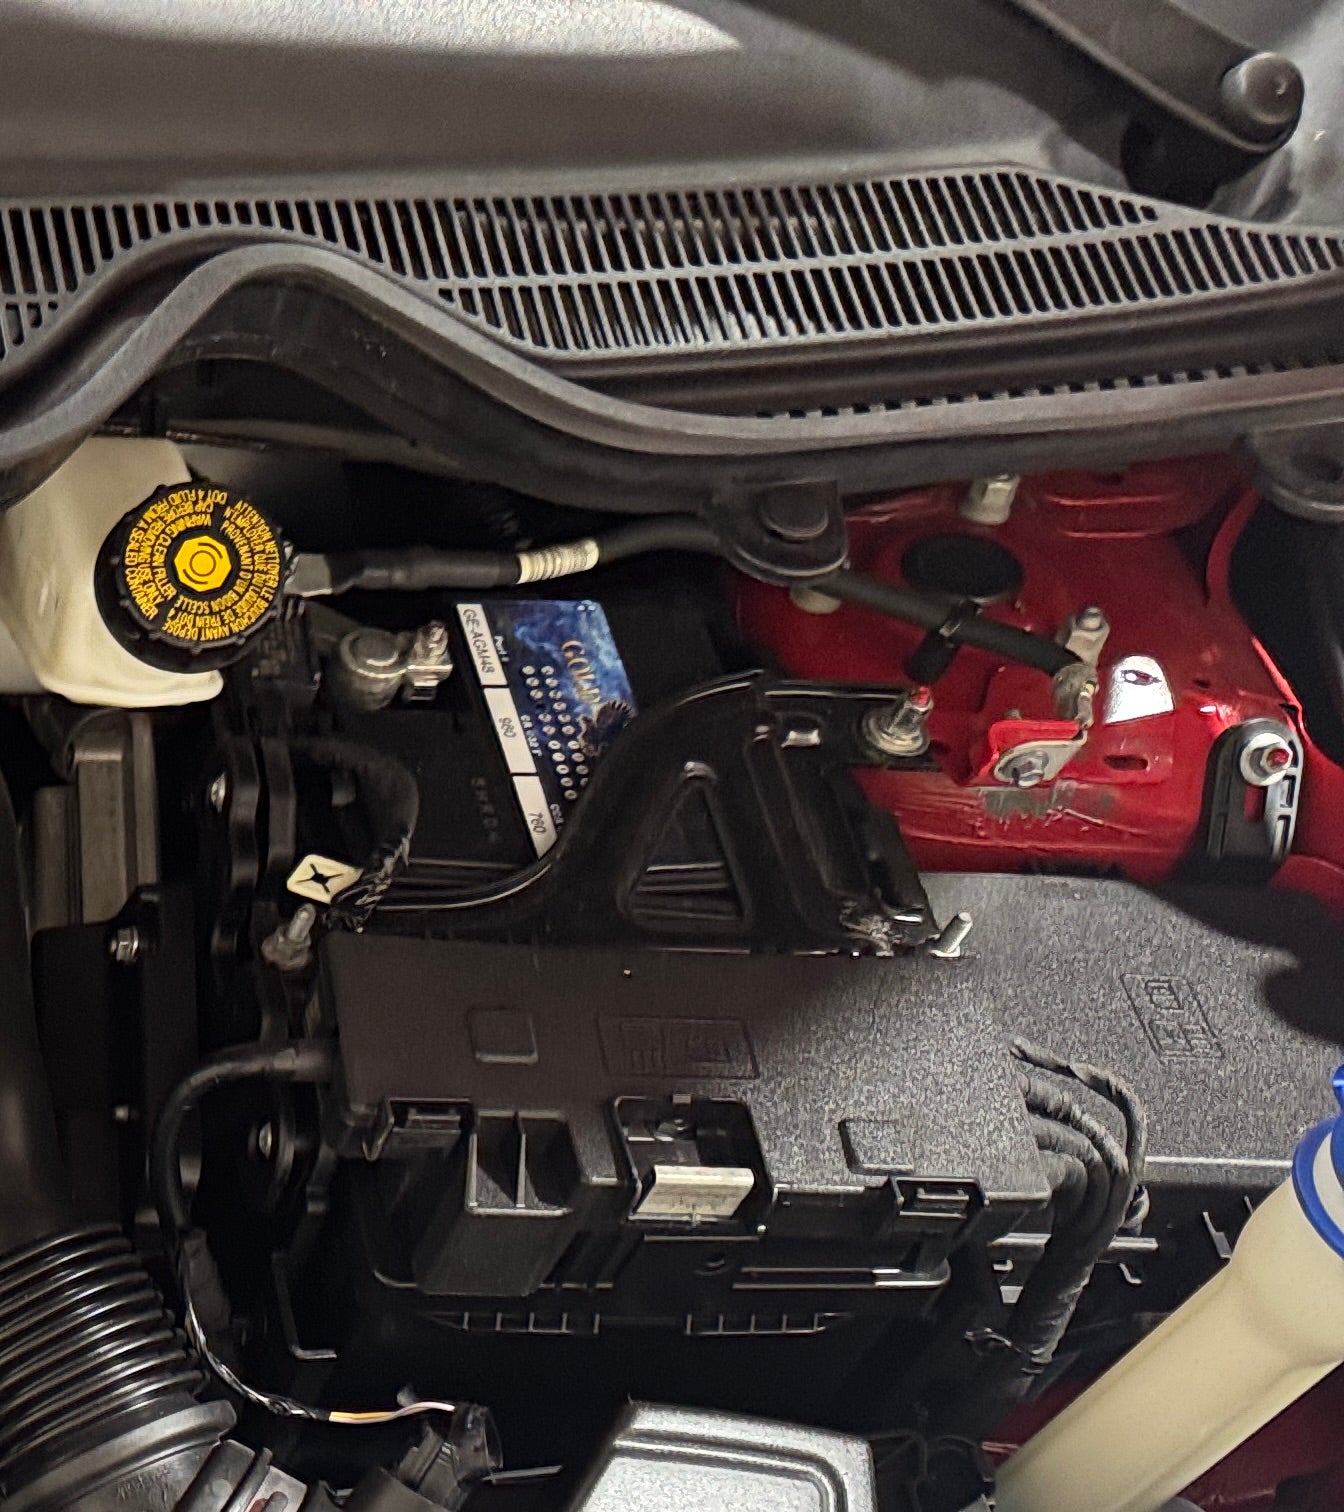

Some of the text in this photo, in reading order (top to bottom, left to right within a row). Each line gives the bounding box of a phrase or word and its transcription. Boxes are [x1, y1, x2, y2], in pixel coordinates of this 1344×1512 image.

[168, 489, 196, 504] FLUID
[208, 489, 227, 505] DOT
[234, 501, 272, 540] ATTENTION
[220, 521, 253, 571] PROVENANT
[265, 540, 280, 583] NETTOYER
[126, 568, 158, 620] CONTAINER
[261, 583, 275, 601] LE
[175, 595, 210, 614] SCELLE
[179, 613, 195, 624] DOT
[222, 611, 235, 622] DE
[201, 627, 230, 641] AVANT
